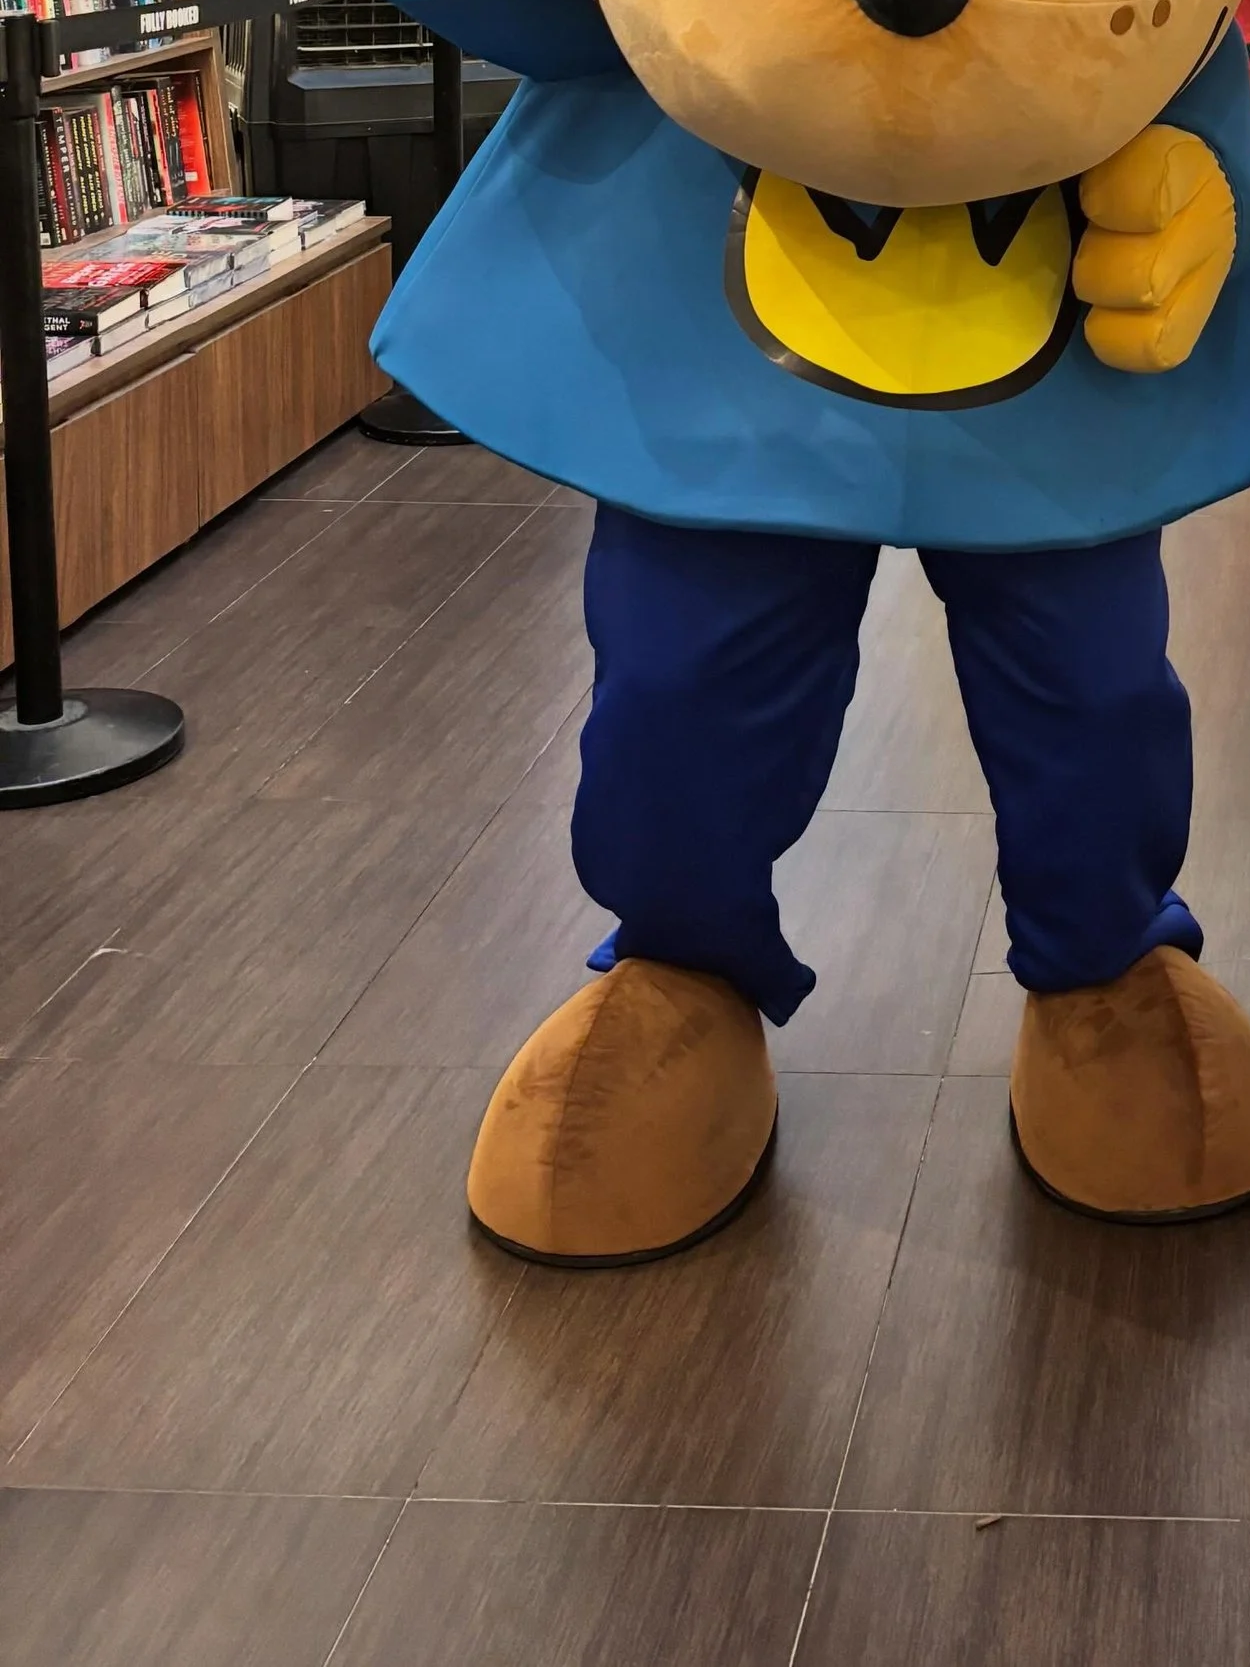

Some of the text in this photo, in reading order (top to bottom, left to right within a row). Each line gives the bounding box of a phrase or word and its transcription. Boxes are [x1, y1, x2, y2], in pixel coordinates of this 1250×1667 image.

[139, 4, 200, 34] FULLY BOOKED
[55, 117, 77, 226] TEMPER LAYNE FARGO
[43, 316, 71, 325] THAL
[43, 324, 69, 332] GENT
